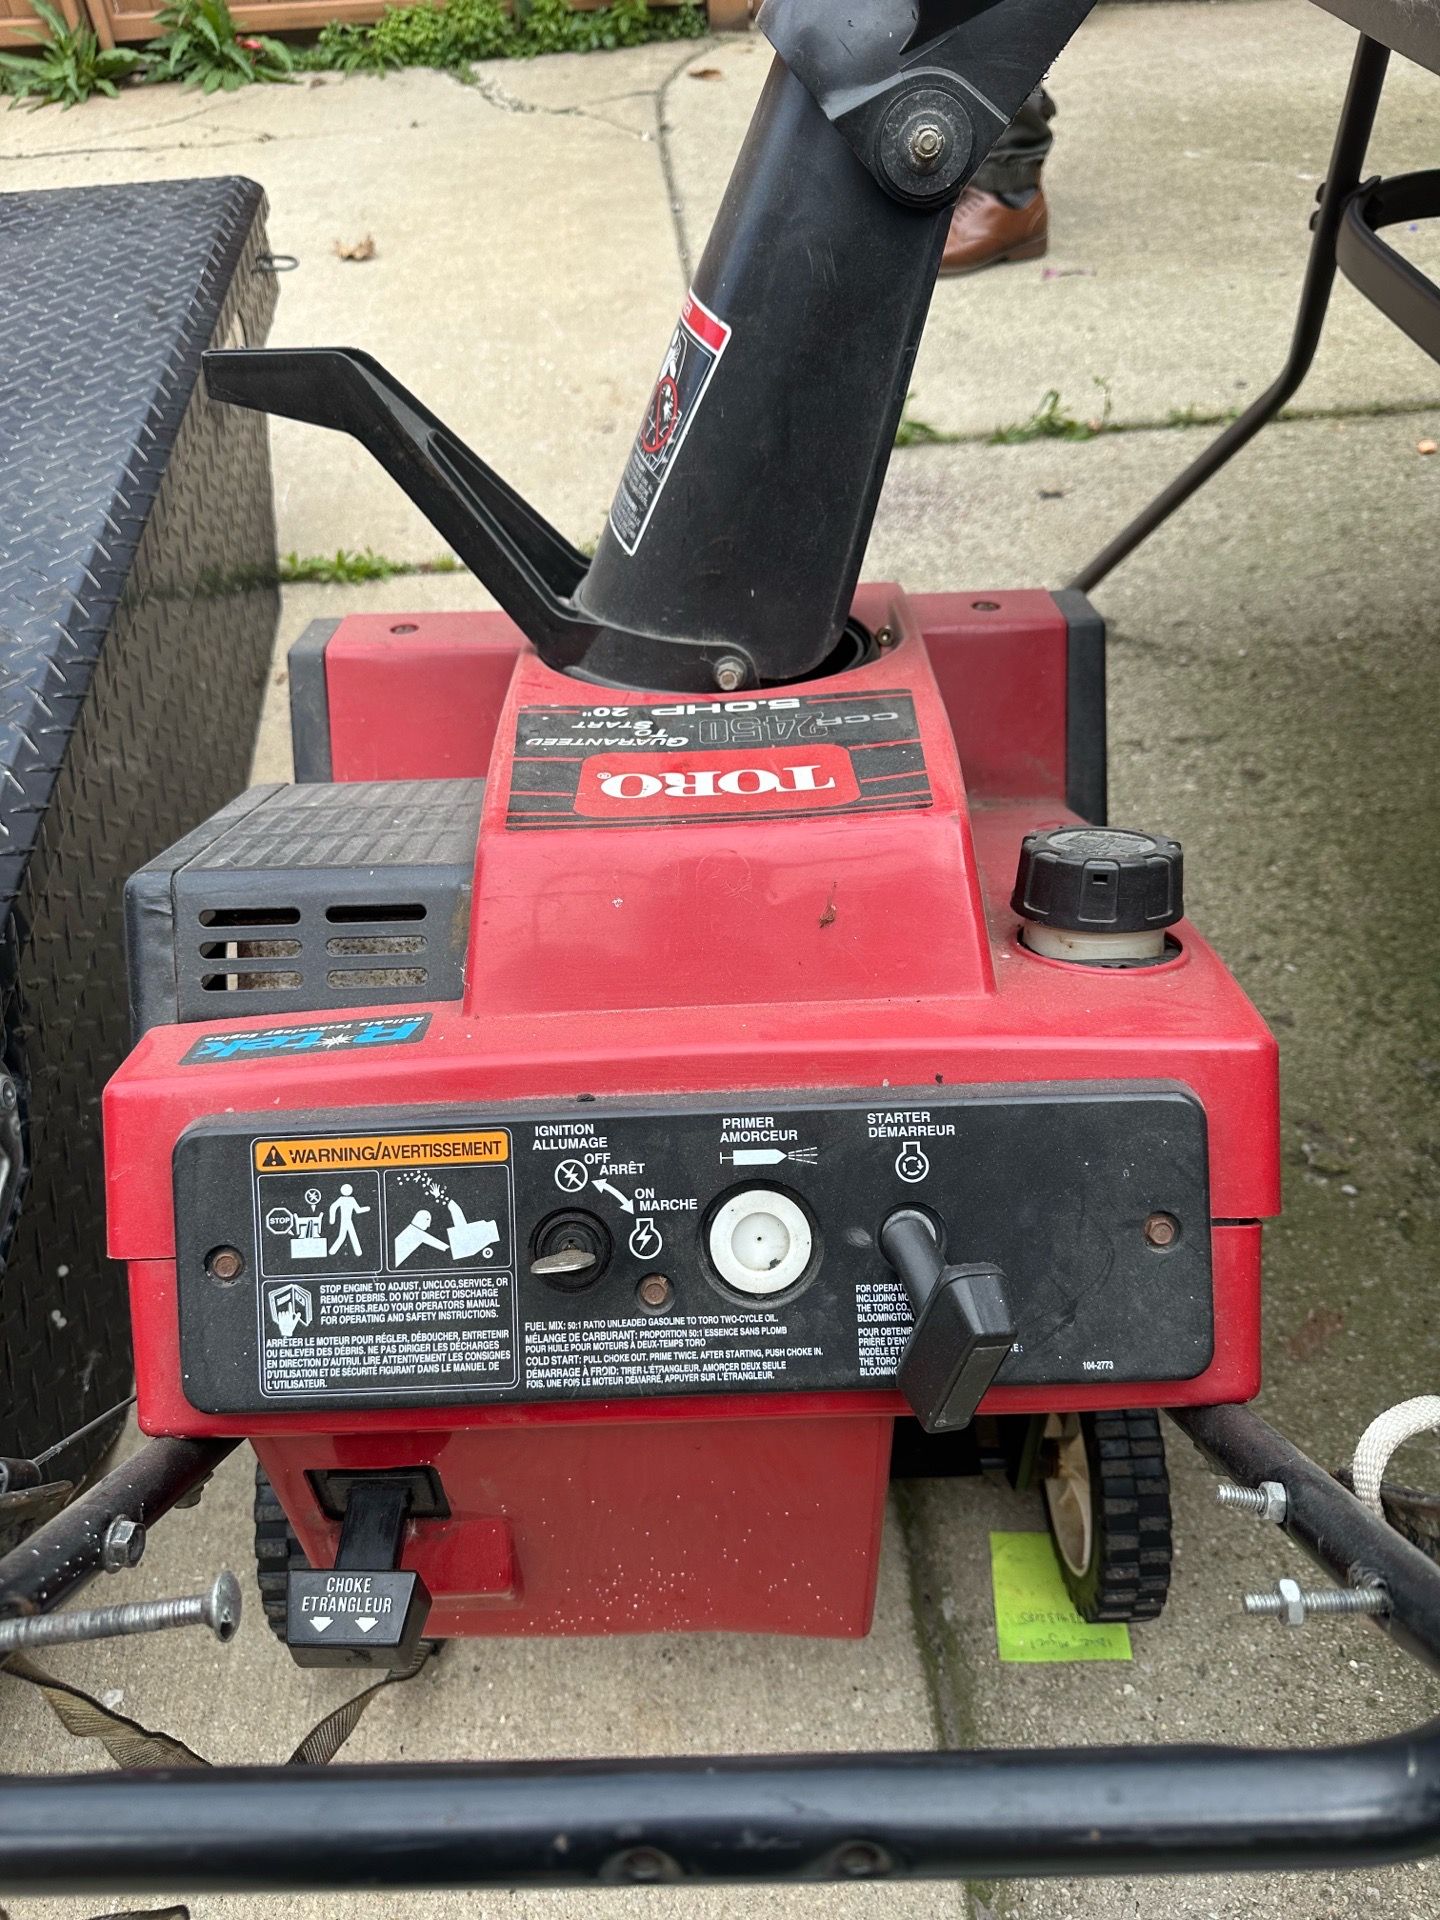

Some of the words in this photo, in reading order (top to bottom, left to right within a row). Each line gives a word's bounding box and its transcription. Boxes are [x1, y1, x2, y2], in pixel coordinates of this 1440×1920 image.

[571, 719, 653, 731] START
[817, 711, 899, 726] CCR
[637, 728, 670, 739] TO
[698, 711, 828, 744] 2450
[526, 736, 689, 748] GUARANTEED
[359, 1016, 425, 1027] Reliable
[267, 1023, 353, 1037] Technology
[203, 1032, 258, 1042] Engine
[722, 1117, 775, 1129] PRIMER
[867, 1111, 930, 1124] STARTER
[535, 1124, 594, 1137] IGNITION
[719, 1130, 798, 1143] AMORCEUR
[868, 1123, 955, 1138] DÉMARREUR
[532, 1137, 608, 1151] ALLUMAGE
[584, 1153, 611, 1165] OFF
[599, 1160, 645, 1176] ARRÊT
[634, 1188, 655, 1199] ON
[639, 1199, 698, 1211] MARCHE
[269, 1216, 291, 1225] STOP
[320, 1285, 341, 1293] STOP
[343, 1283, 372, 1293] ENGINE
[375, 1283, 386, 1291] TO
[495, 1278, 508, 1287] OR
[856, 1284, 871, 1293] FOR
[320, 1294, 353, 1304] REMOVE
[389, 1292, 401, 1301] DO
[402, 1292, 418, 1301] NOT
[421, 1290, 449, 1300] DIRECT
[451, 1288, 498, 1299] DISCHARGE
[856, 1294, 896, 1303] INCLUDING
[320, 1305, 330, 1314] AT
[390, 1302, 413, 1311] YOUR
[415, 1300, 464, 1311] OPERATORS
[466, 1298, 500, 1309] MANUAL
[856, 1304, 871, 1312] THE
[873, 1304, 894, 1312] TORO
[321, 1316, 337, 1325] FOR
[339, 1314, 385, 1324] OPERATING
[387, 1313, 404, 1322] AND
[405, 1312, 436, 1321] SAFETY
[525, 1322, 546, 1331] FUEL
[583, 1320, 605, 1329] RATIO
[607, 1318, 646, 1329] UNLEADED
[648, 1317, 684, 1327] GASOLINE
[687, 1317, 696, 1326] TO
[698, 1316, 718, 1325] TORO
[304, 1337, 314, 1346] LE
[316, 1336, 349, 1346] MOTEUR
[351, 1335, 373, 1344] POUR
[462, 1330, 509, 1340] ENTRETENIR
[526, 1332, 566, 1344] MÉLANGE
[568, 1333, 580, 1343] DE
[639, 1330, 689, 1340] PROPORTION
[704, 1328, 738, 1338] ESSENCE
[739, 1327, 759, 1337] SANS
[761, 1326, 787, 1336] PLOMB
[857, 1328, 879, 1336] POUR
[266, 1349, 277, 1358] OU
[279, 1348, 314, 1357] ENLEVER
[316, 1347, 332, 1356] DES
[367, 1345, 378, 1354] NE
[380, 1345, 396, 1354] PAS
[398, 1343, 430, 1353] DIRIGER
[432, 1343, 448, 1352] LES
[449, 1339, 500, 1351] DÉCHARGES
[526, 1345, 546, 1354] POUR
[547, 1344, 569, 1353] HUILE
[570, 1343, 591, 1352] POUR
[592, 1341, 628, 1351] MOTEURS
[685, 1338, 706, 1348] TORO
[890, 1347, 901, 1355] ET
[266, 1359, 277, 1368] EN
[279, 1357, 321, 1368] DIRECTION
[362, 1355, 380, 1365] LIRE
[382, 1353, 445, 1364] ATTENTIVEMENT
[448, 1352, 463, 1362] LES
[464, 1350, 511, 1361] CONSIGNES
[526, 1356, 549, 1366] COLD
[583, 1354, 602, 1364] PULL
[603, 1353, 629, 1364] CHOKE
[649, 1352, 671, 1362] PRIME
[700, 1350, 724, 1360] AFTER
[765, 1348, 785, 1358] PUSH
[786, 1347, 812, 1357] CHOKE
[813, 1347, 823, 1356] IN.
[859, 1357, 874, 1366] THE
[876, 1357, 896, 1365] TORO
[319, 1368, 328, 1377] ET
[330, 1367, 340, 1376] DE
[341, 1364, 377, 1376] SÉCURITÉ
[378, 1364, 415, 1375] FIGURANT
[417, 1364, 439, 1373] DANS
[441, 1363, 451, 1372] LE
[453, 1362, 486, 1372] MANUEL
[488, 1361, 499, 1371] DE
[526, 1366, 580, 1379] DÉMARRAGE
[620, 1366, 642, 1376] TIRER
[702, 1362, 739, 1373] AMORCER
[740, 1362, 760, 1372] DEUX
[762, 1361, 786, 1371] SEULE
[1082, 1360, 1114, 1370] 104-2773
[546, 1379, 561, 1388] UNE
[563, 1378, 580, 1387] FOIS
[581, 1378, 590, 1387] LE
[592, 1377, 623, 1386] MOTEUR
[664, 1374, 698, 1383] APPUYER
[700, 1374, 715, 1382] SUR
[326, 1577, 372, 1593] CHOKE
[301, 1596, 392, 1613] ETRANGLEUR
